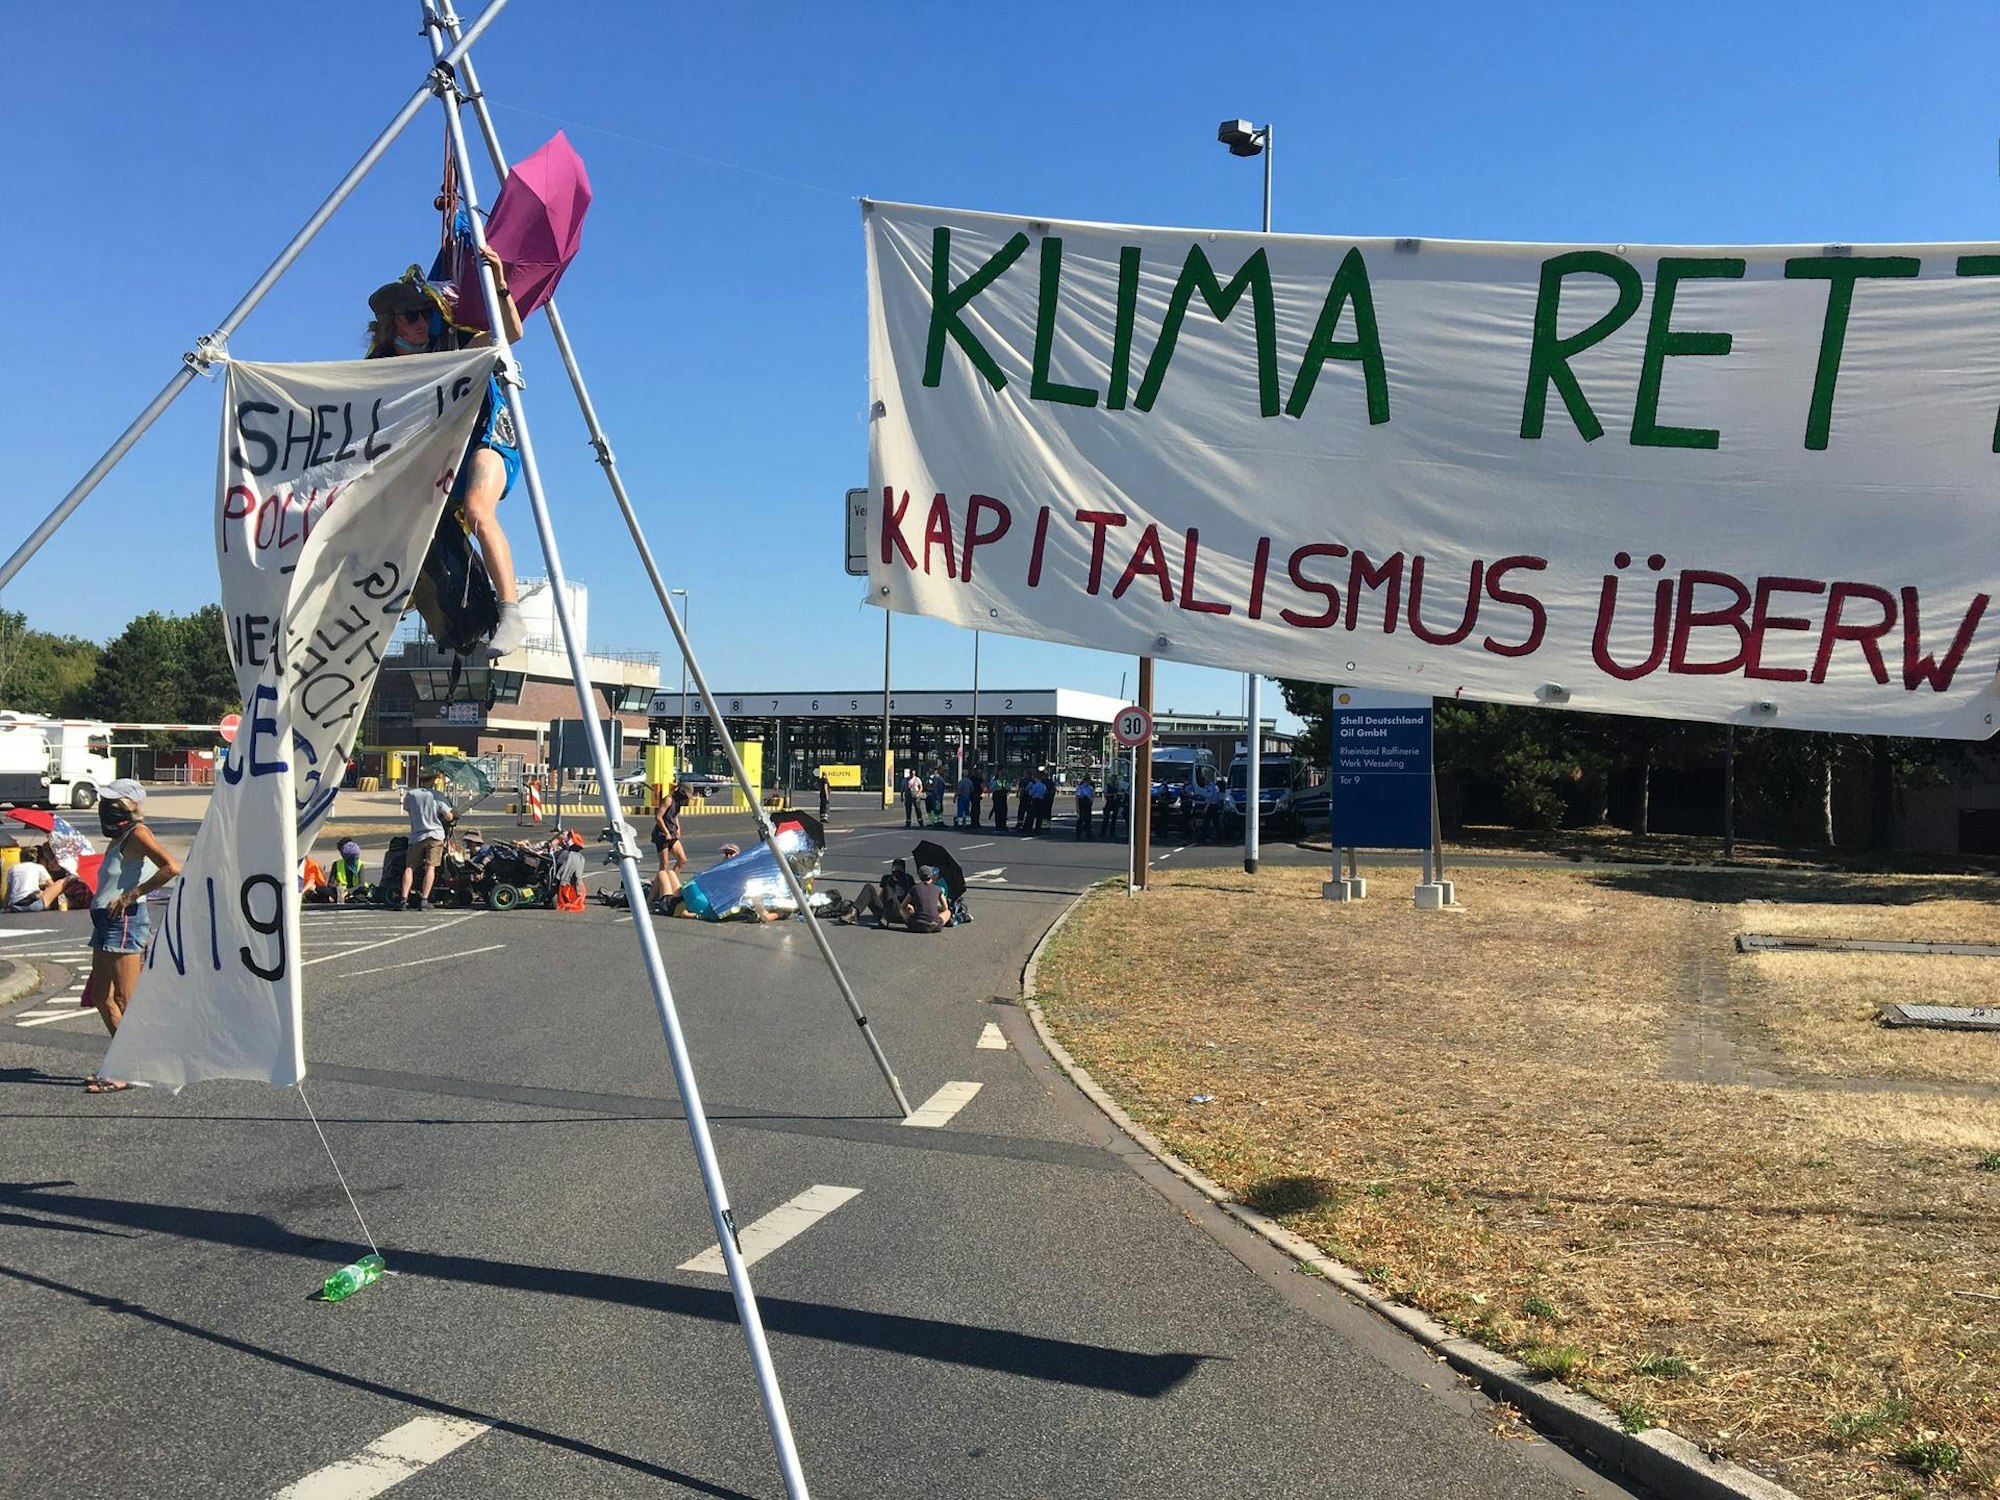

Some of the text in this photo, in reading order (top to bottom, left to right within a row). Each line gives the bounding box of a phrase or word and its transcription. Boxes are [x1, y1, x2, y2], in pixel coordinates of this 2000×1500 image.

[922, 226, 1390, 425] KLIMA
[229, 398, 393, 476] SHELL
[881, 486, 2000, 694] KAPITALISMUS ÜBERW
[653, 699, 1013, 712] 10 9 8 7 6 5 4 3 2
[1124, 717, 1141, 735] 30
[1340, 715, 1424, 725] Shell Deutschland
[1340, 728, 1388, 738] Oil GmbH
[1340, 746, 1420, 756] Rheinland Raffinerie
[1340, 759, 1405, 770] Werk Wesseling
[1340, 775, 1361, 784] Tor 9
